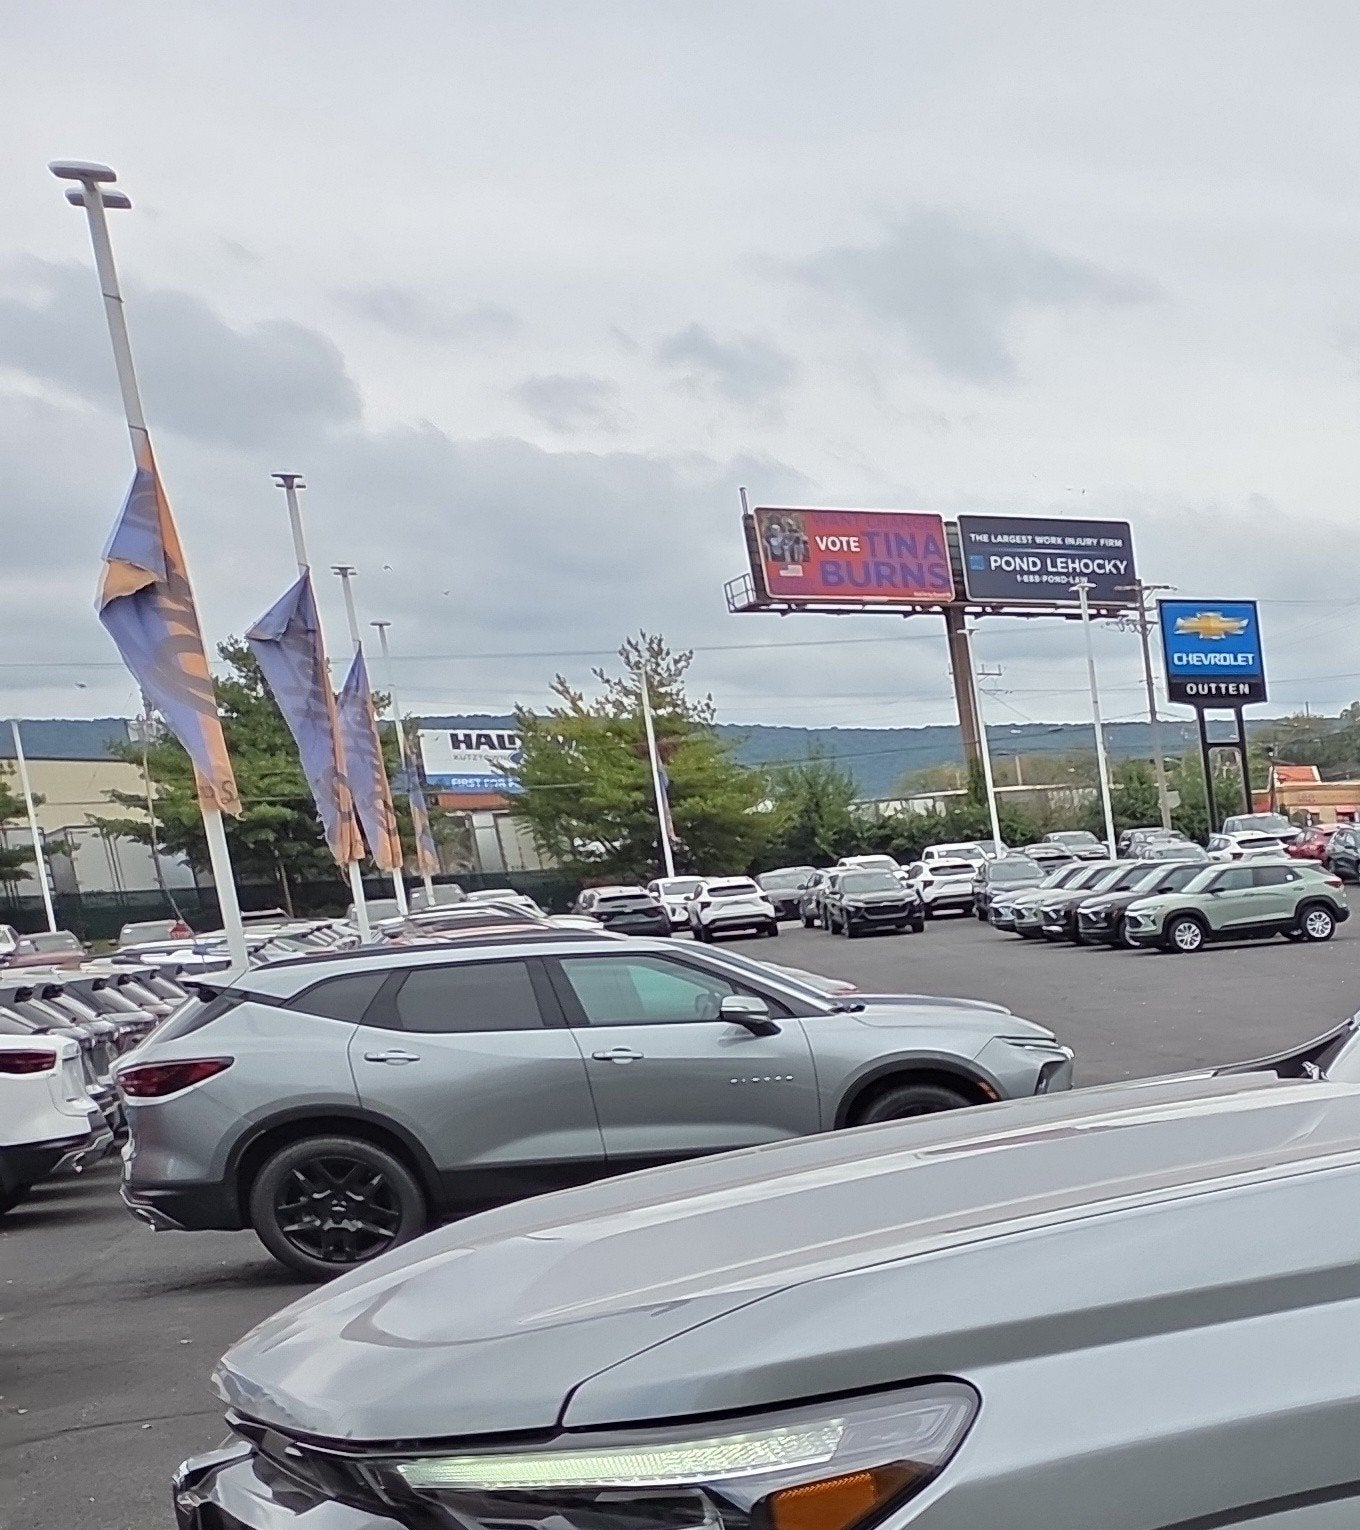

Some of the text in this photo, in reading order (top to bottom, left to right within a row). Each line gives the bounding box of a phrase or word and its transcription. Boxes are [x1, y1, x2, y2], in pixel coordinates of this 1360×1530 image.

[815, 530, 945, 559] VOTE TINA
[970, 533, 1123, 548] THE LARGEST WORK INJURY FIRM
[989, 555, 1128, 575] POND LEHOCKY
[819, 560, 951, 589] BURNS
[1173, 652, 1255, 666] CHEVROLET
[1185, 683, 1250, 695] OUTTEN
